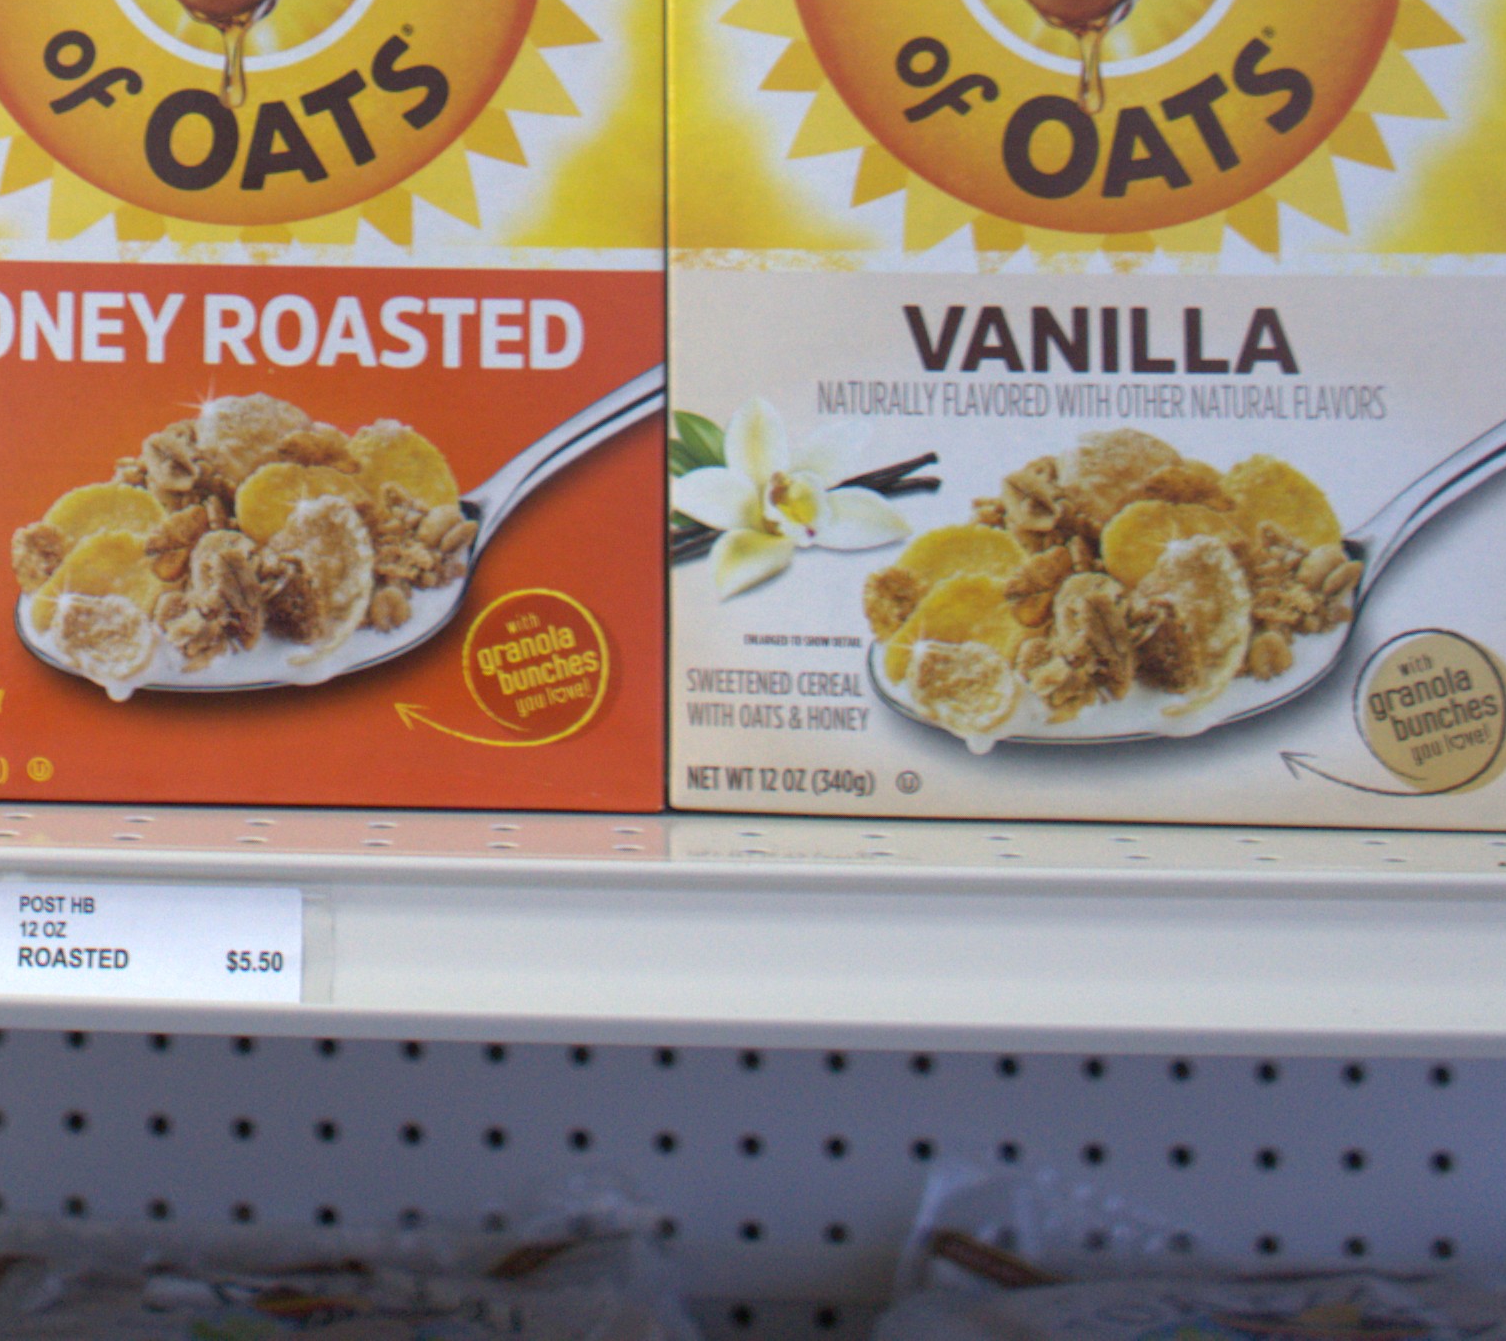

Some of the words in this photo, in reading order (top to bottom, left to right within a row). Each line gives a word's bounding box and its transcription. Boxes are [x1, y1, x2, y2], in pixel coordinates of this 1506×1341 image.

[144, 31, 451, 192] OATS
[1002, 37, 1316, 200] OATS
[202, 293, 584, 371] ROASTED
[901, 301, 1300, 375] VANILLA
[816, 379, 938, 418] NATURALLY
[944, 380, 1051, 419] FLAVORED
[1055, 381, 1113, 419] WITH
[1117, 381, 1186, 420] OTHER
[1190, 383, 1288, 420] NATURAL
[1292, 384, 1387, 421] FLAVORS
[505, 613, 541, 634] with
[476, 625, 577, 676] granola
[496, 650, 601, 695] bunches
[19, 896, 66, 914] POST
[71, 897, 95, 914] HB
[20, 921, 39, 938] 12
[43, 921, 67, 938] OZ
[17, 947, 129, 970] ROASTED
[226, 950, 284, 973] $5.50
